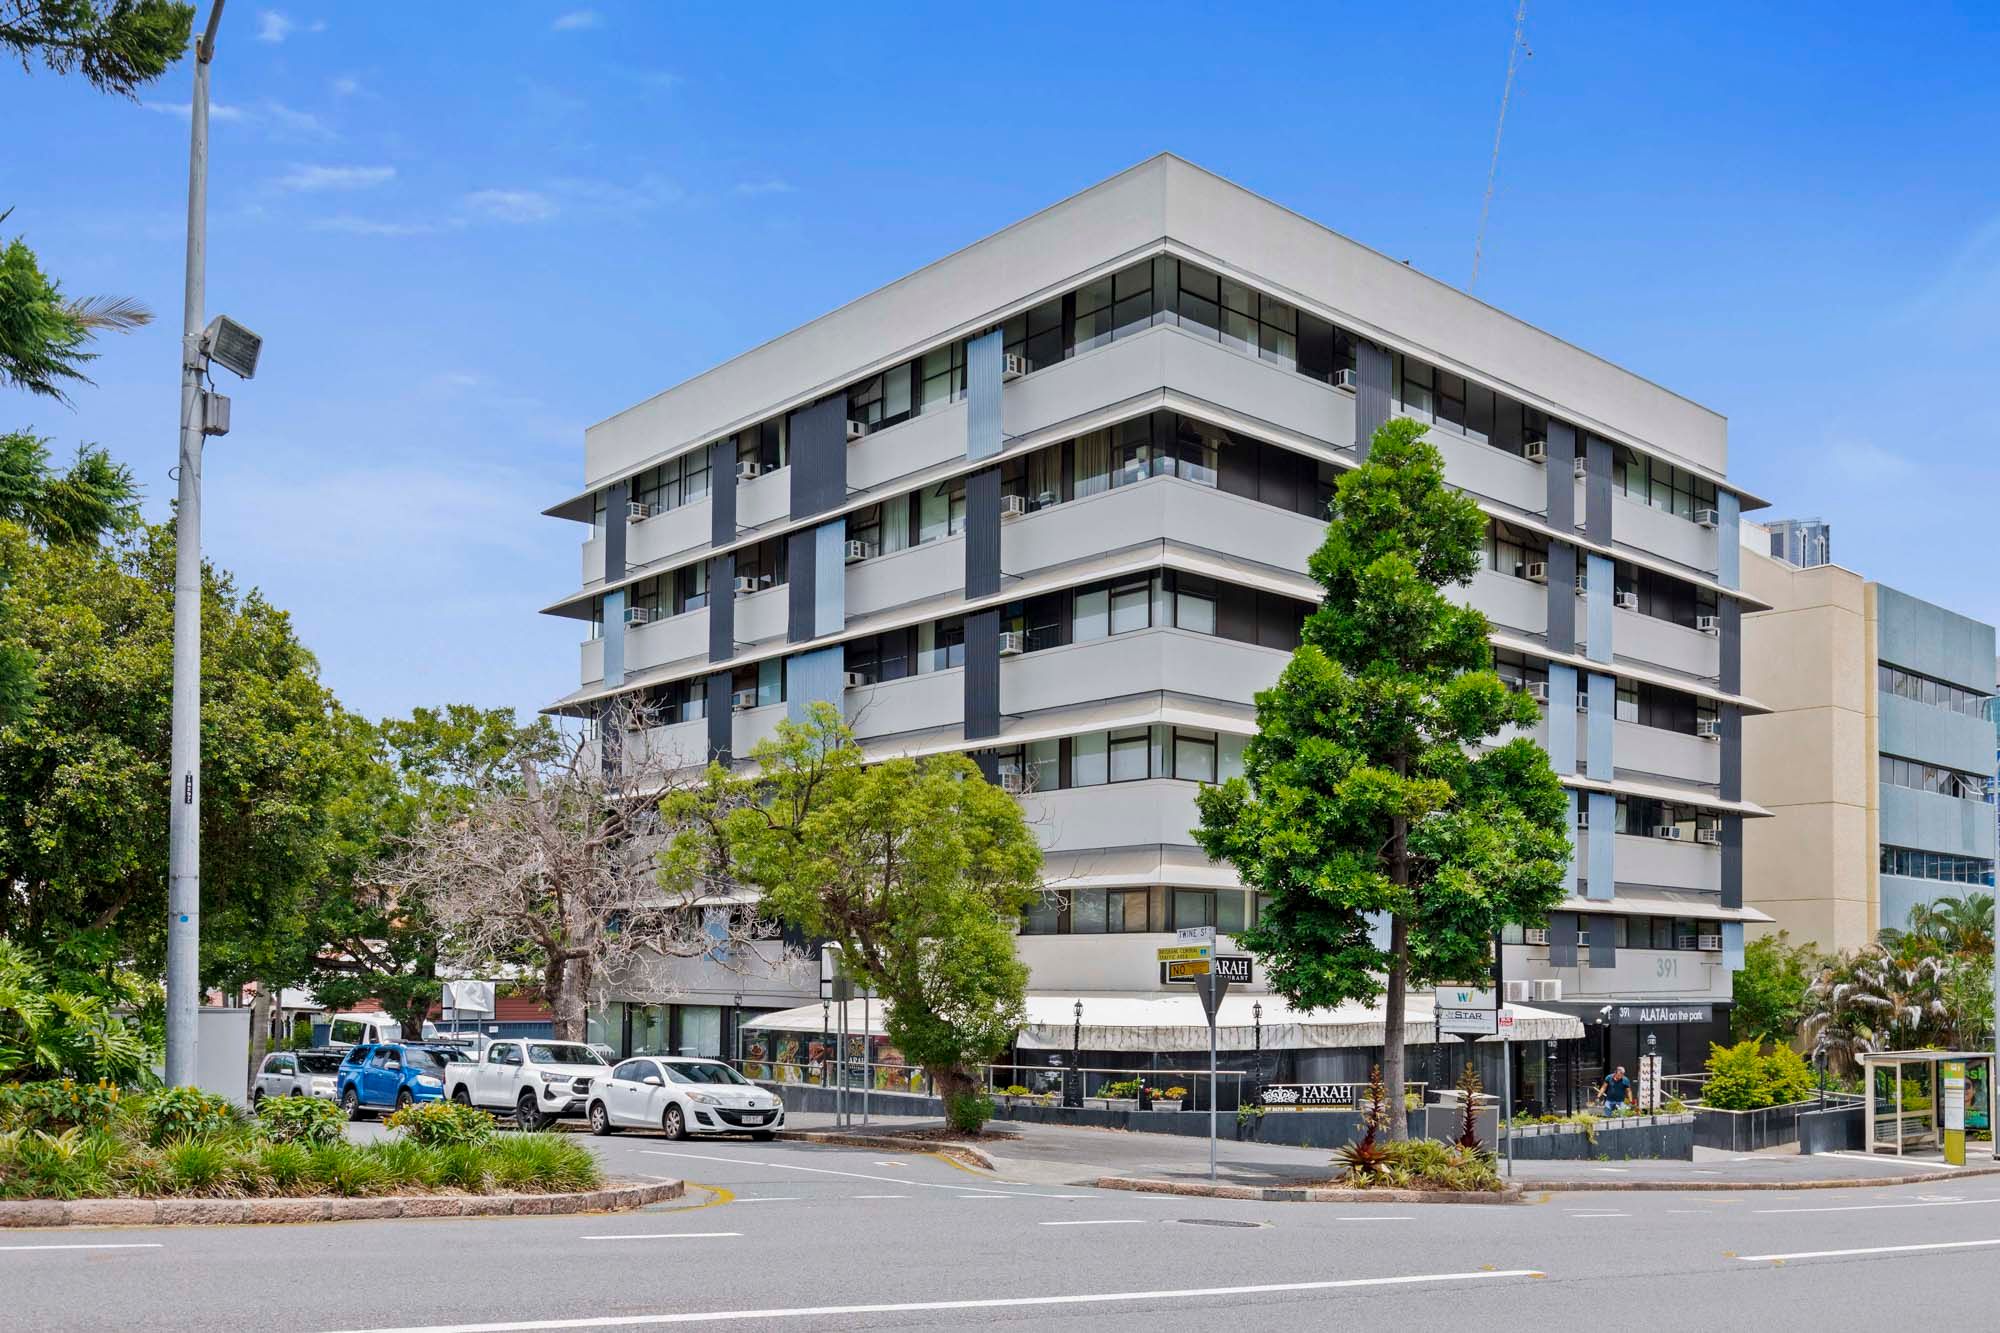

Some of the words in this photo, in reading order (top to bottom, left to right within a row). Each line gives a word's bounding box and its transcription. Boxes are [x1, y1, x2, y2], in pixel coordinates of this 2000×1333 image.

[1178, 928, 1197, 939] TWINE
[1173, 965, 1185, 976] NO
[1215, 960, 1248, 975] ARAH
[1656, 958, 1677, 977] 391
[1619, 1007, 1630, 1017] 391
[1640, 1008, 1668, 1022] ALATAI
[1669, 1013, 1677, 1021] on
[1678, 1011, 1688, 1020] the
[1689, 1010, 1703, 1022] park
[1302, 1086, 1352, 1098] FARAH
